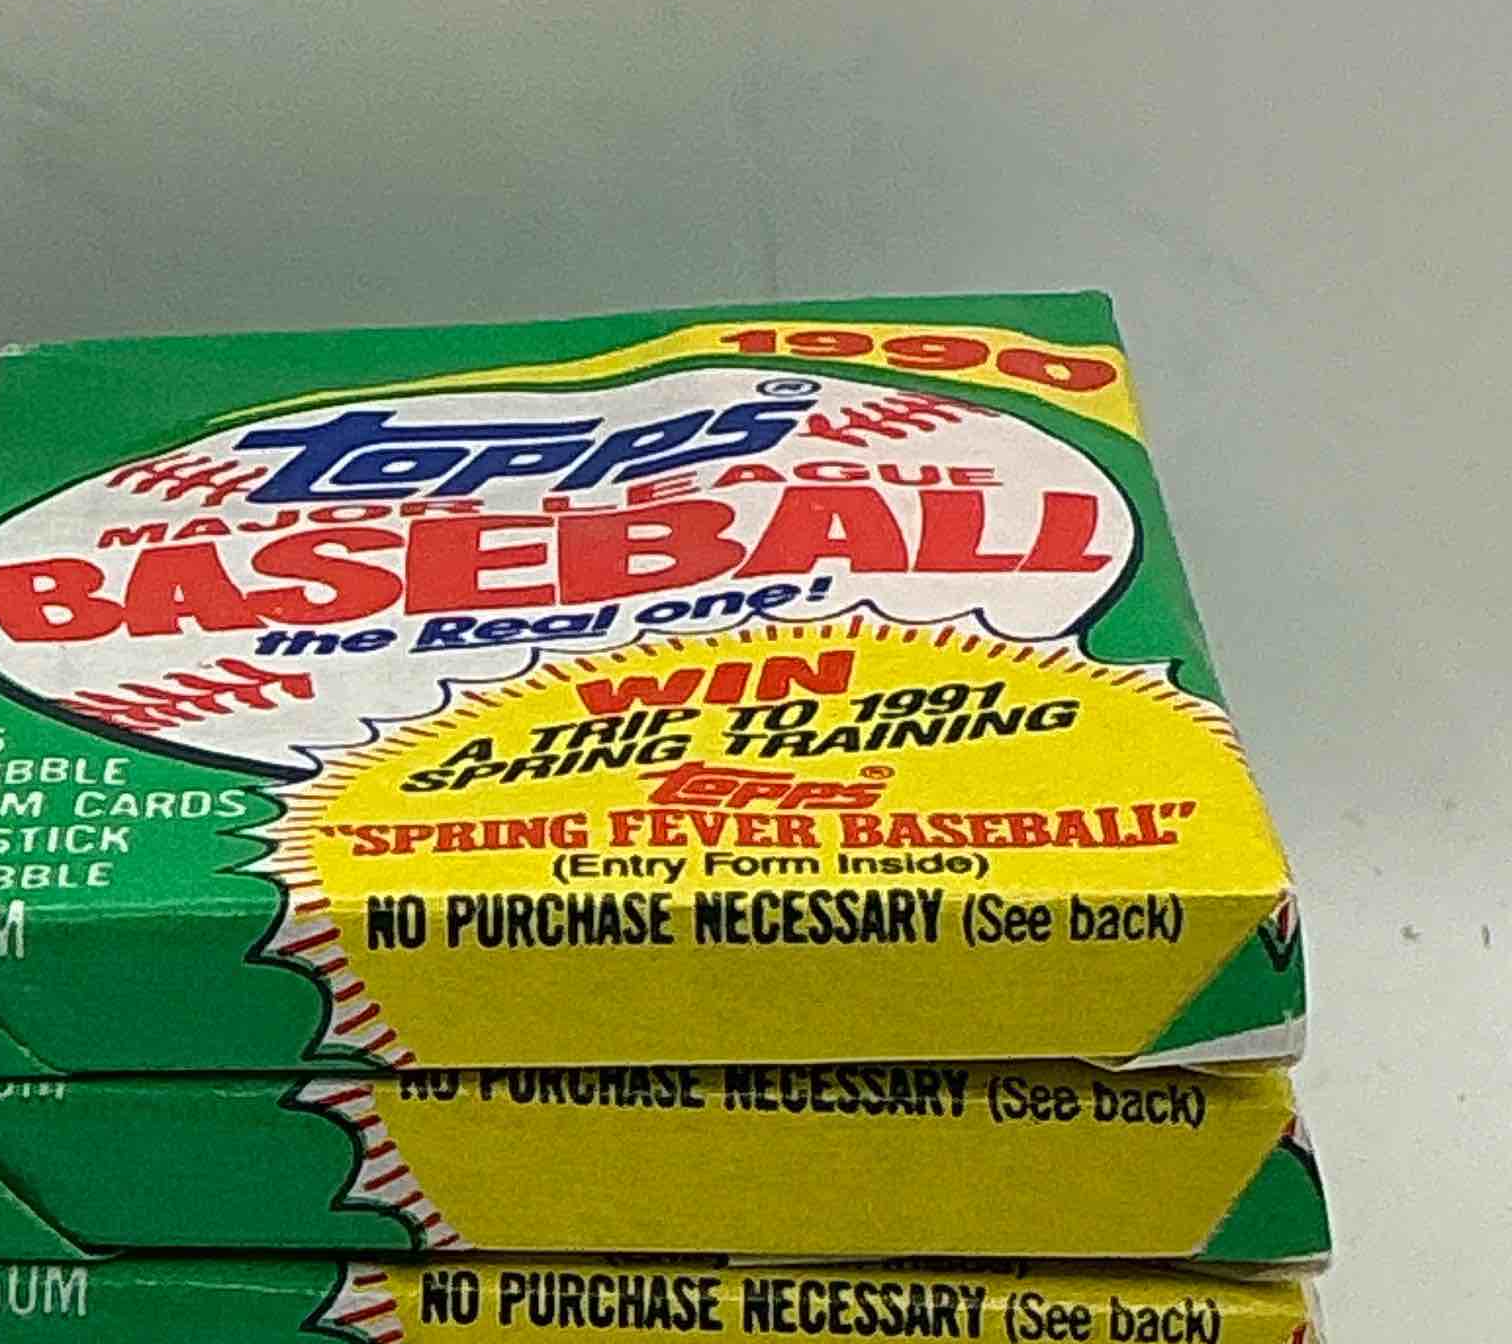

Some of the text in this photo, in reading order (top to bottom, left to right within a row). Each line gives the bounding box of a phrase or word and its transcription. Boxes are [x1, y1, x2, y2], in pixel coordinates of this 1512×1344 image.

[720, 328, 1117, 392] 1990
[98, 461, 1003, 550] MAJOR LEAGUE
[254, 576, 833, 656] the Real one!
[575, 649, 856, 716] WIN
[398, 699, 1082, 793] SPRING TRAINING
[438, 681, 1006, 768] A TRIP TO 1991
[73, 789, 248, 819] CARDS
[610, 807, 822, 849] FEVER
[552, 852, 989, 884] (Entry Form Inside)
[367, 888, 1185, 949] NO PURCHASE NECESSARY (See back)
[479, 1066, 705, 1108] PURCHASE
[723, 1064, 969, 1117] NECESSARY
[987, 1075, 1081, 1123] (See
[1091, 1080, 1207, 1129] back)
[420, 1270, 480, 1324] NO
[498, 1270, 723, 1331] PURCHASE
[741, 1277, 986, 1338] NECESSARY
[1002, 1290, 1093, 1344] (See
